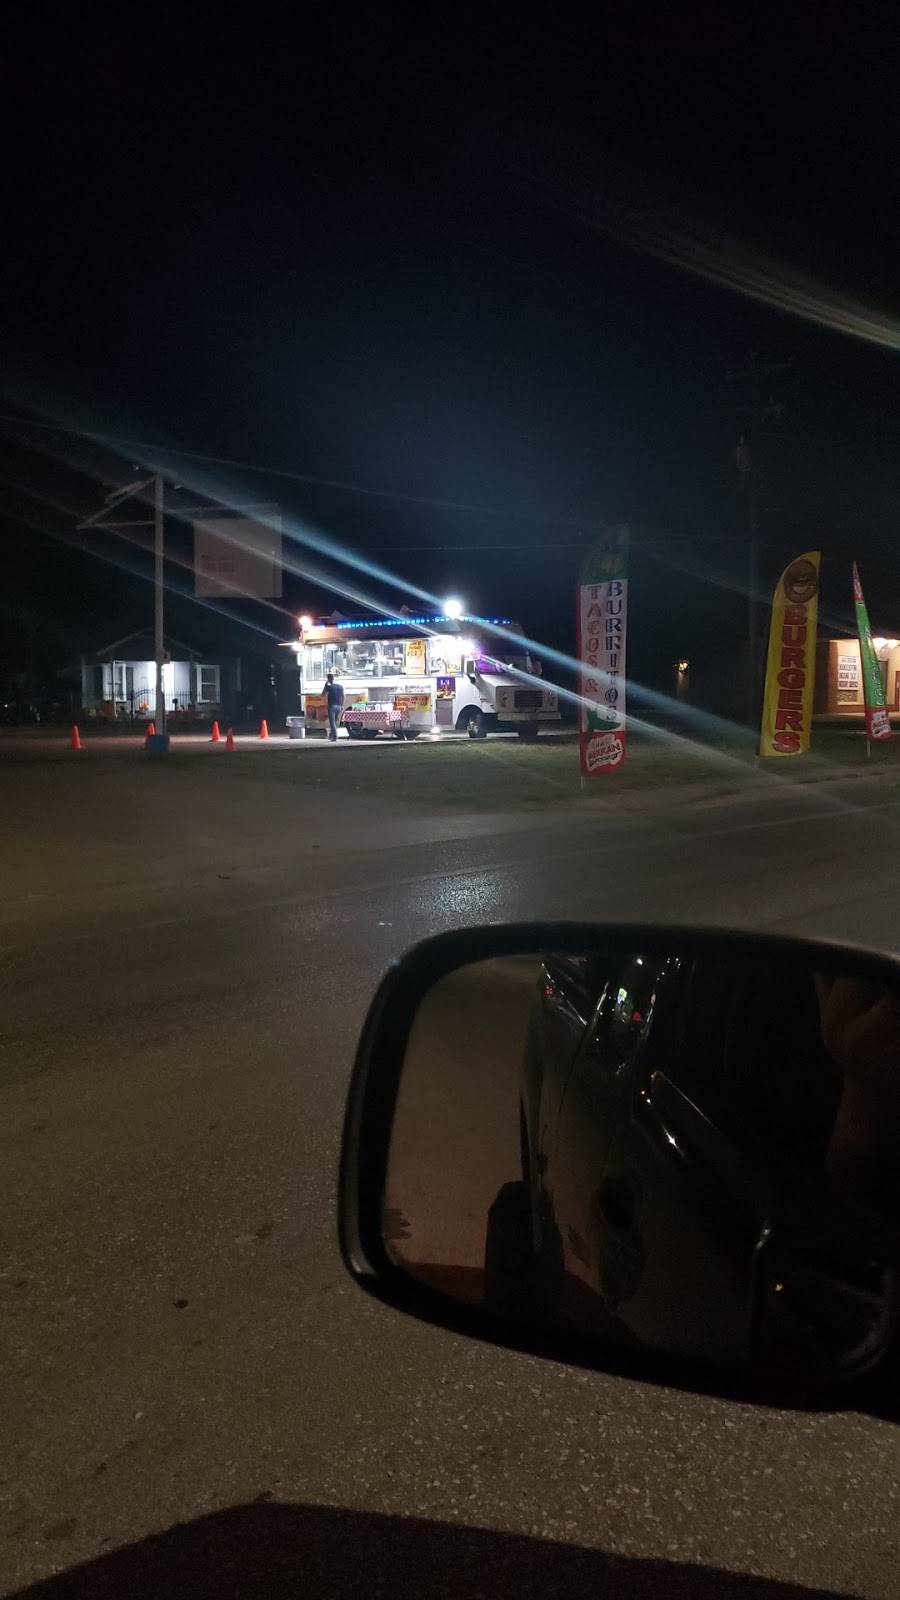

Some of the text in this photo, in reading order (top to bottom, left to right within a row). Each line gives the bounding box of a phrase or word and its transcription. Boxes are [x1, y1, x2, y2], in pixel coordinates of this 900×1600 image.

[587, 585, 602, 668] TACOS
[605, 581, 623, 721] BURRITOS
[773, 604, 808, 753] BURGERS
